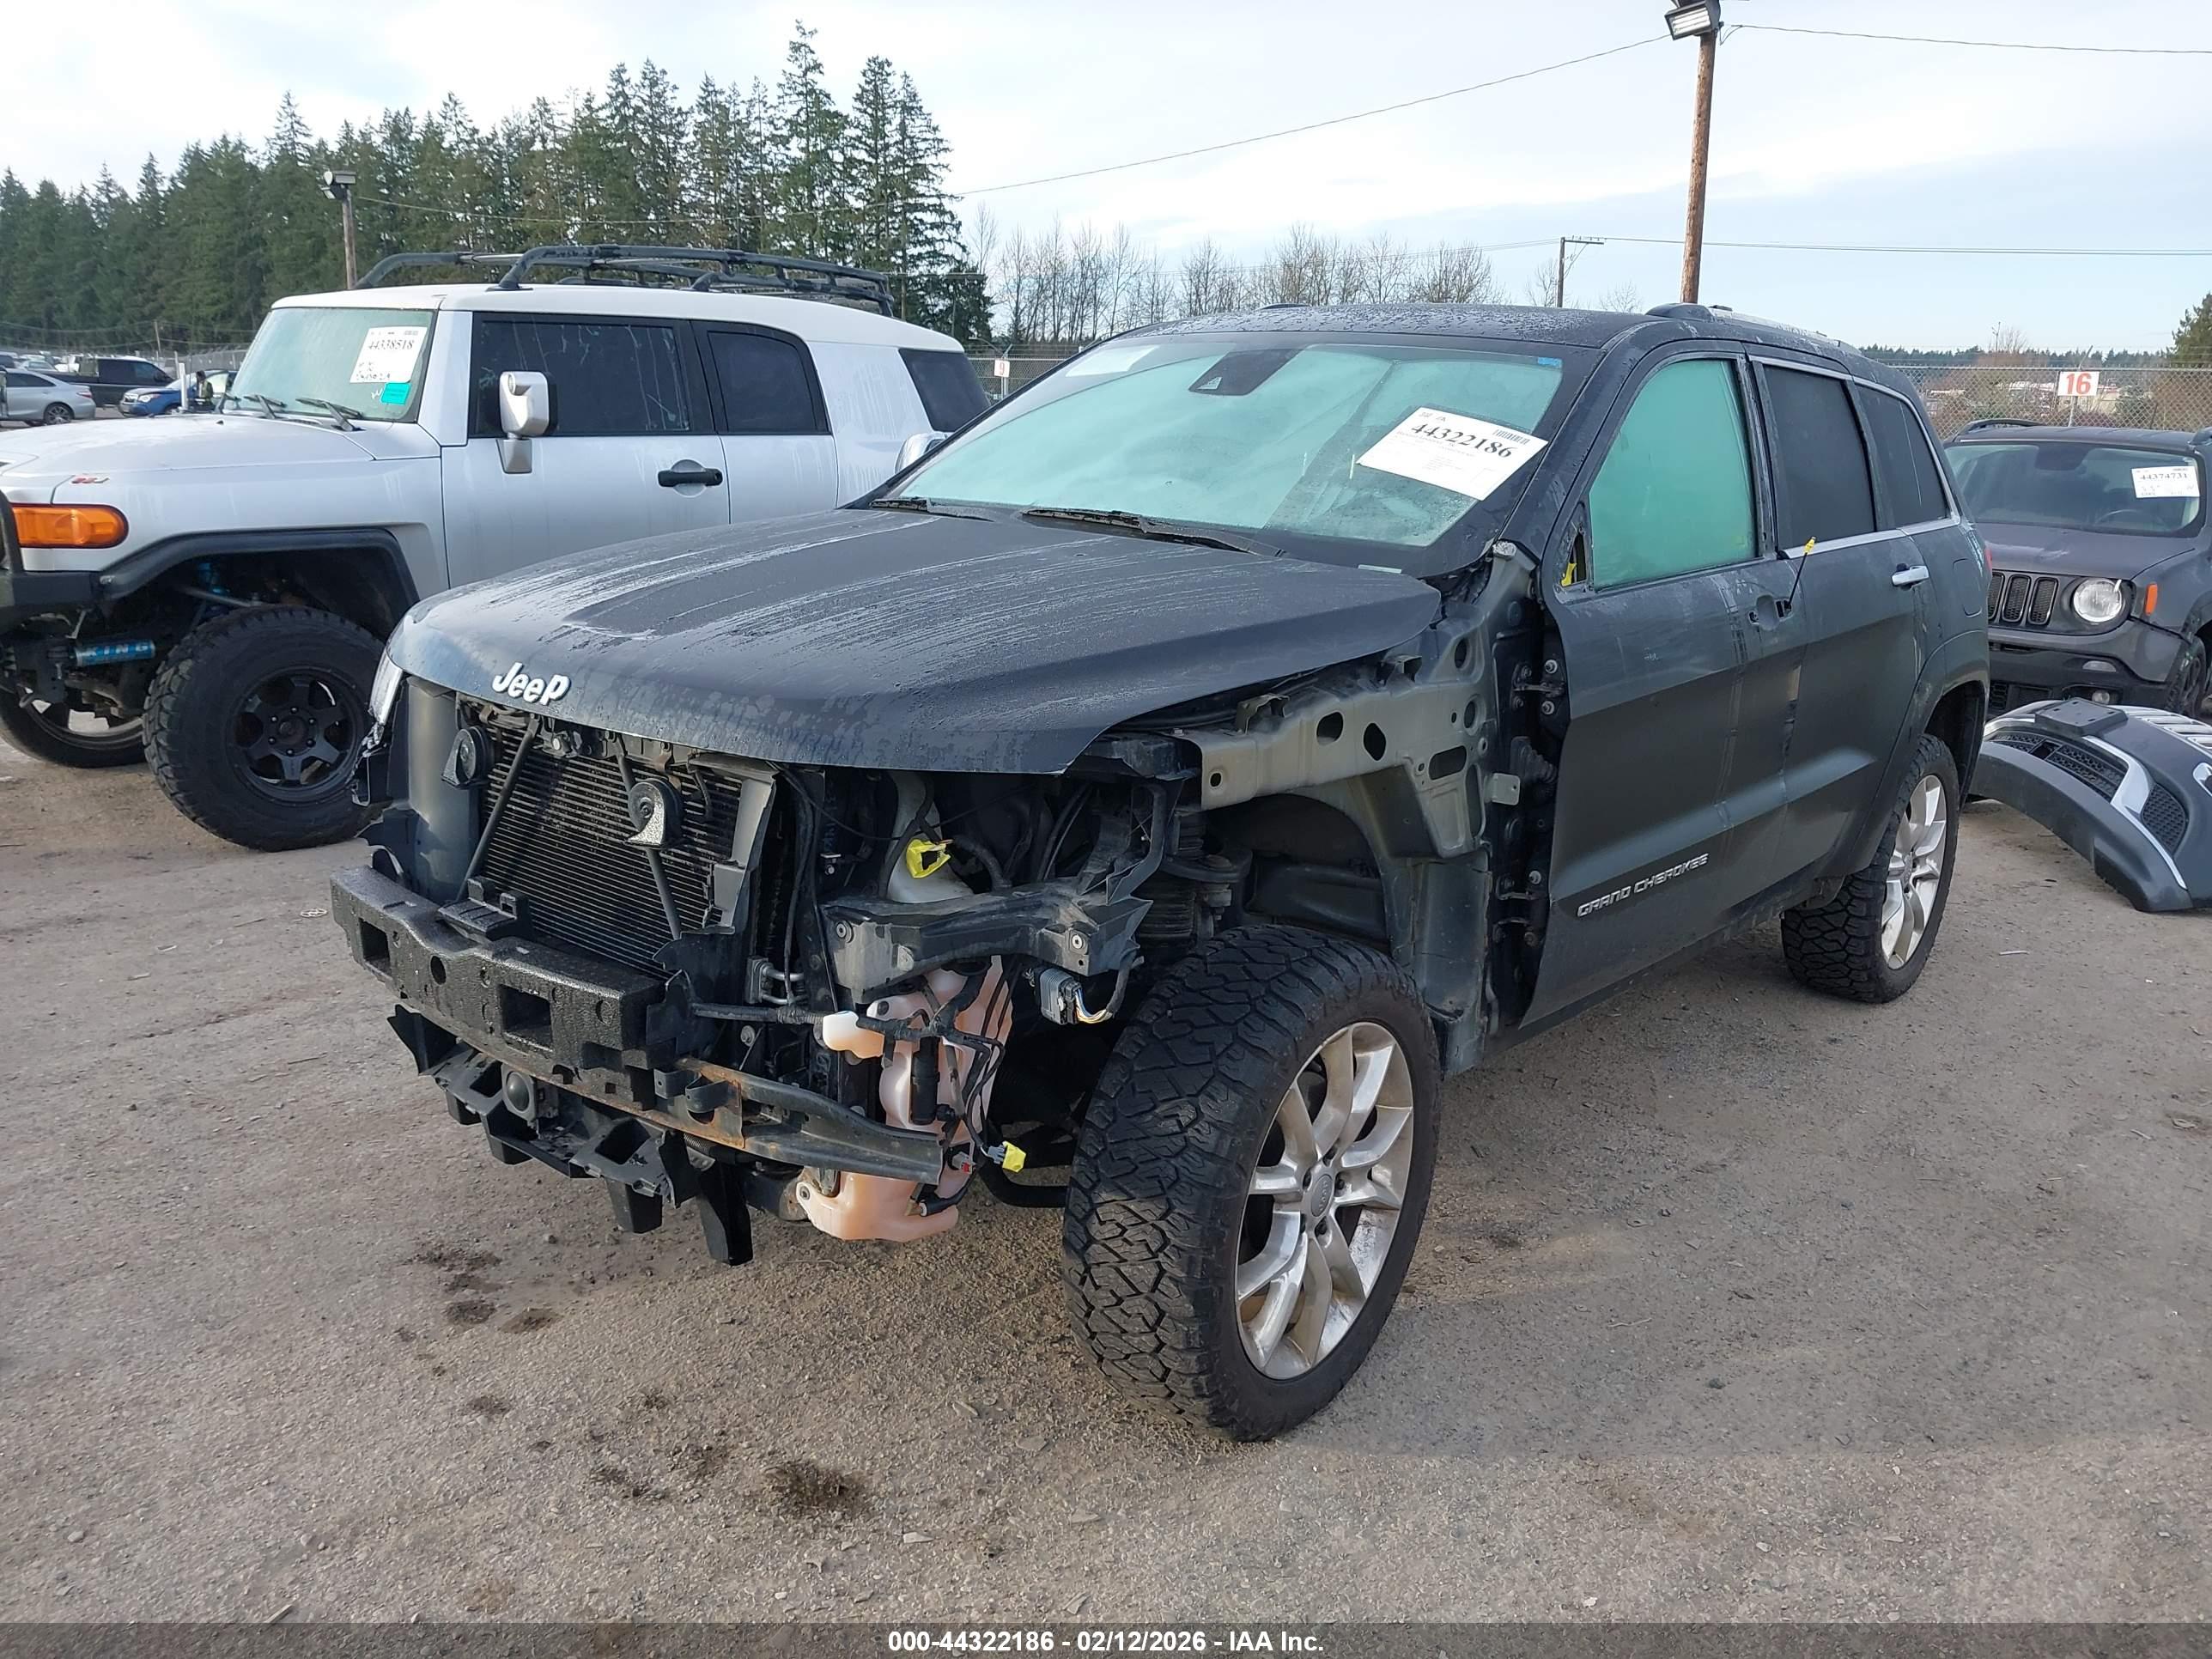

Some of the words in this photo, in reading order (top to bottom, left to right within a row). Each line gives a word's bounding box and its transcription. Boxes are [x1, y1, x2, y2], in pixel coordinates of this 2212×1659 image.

[2066, 373, 2092, 395] 16
[1411, 423, 1517, 458] 44322186
[491, 661, 571, 706] Jeep
[1577, 885, 1632, 917] GRAND
[1633, 853, 1710, 894] CHEROKEE
